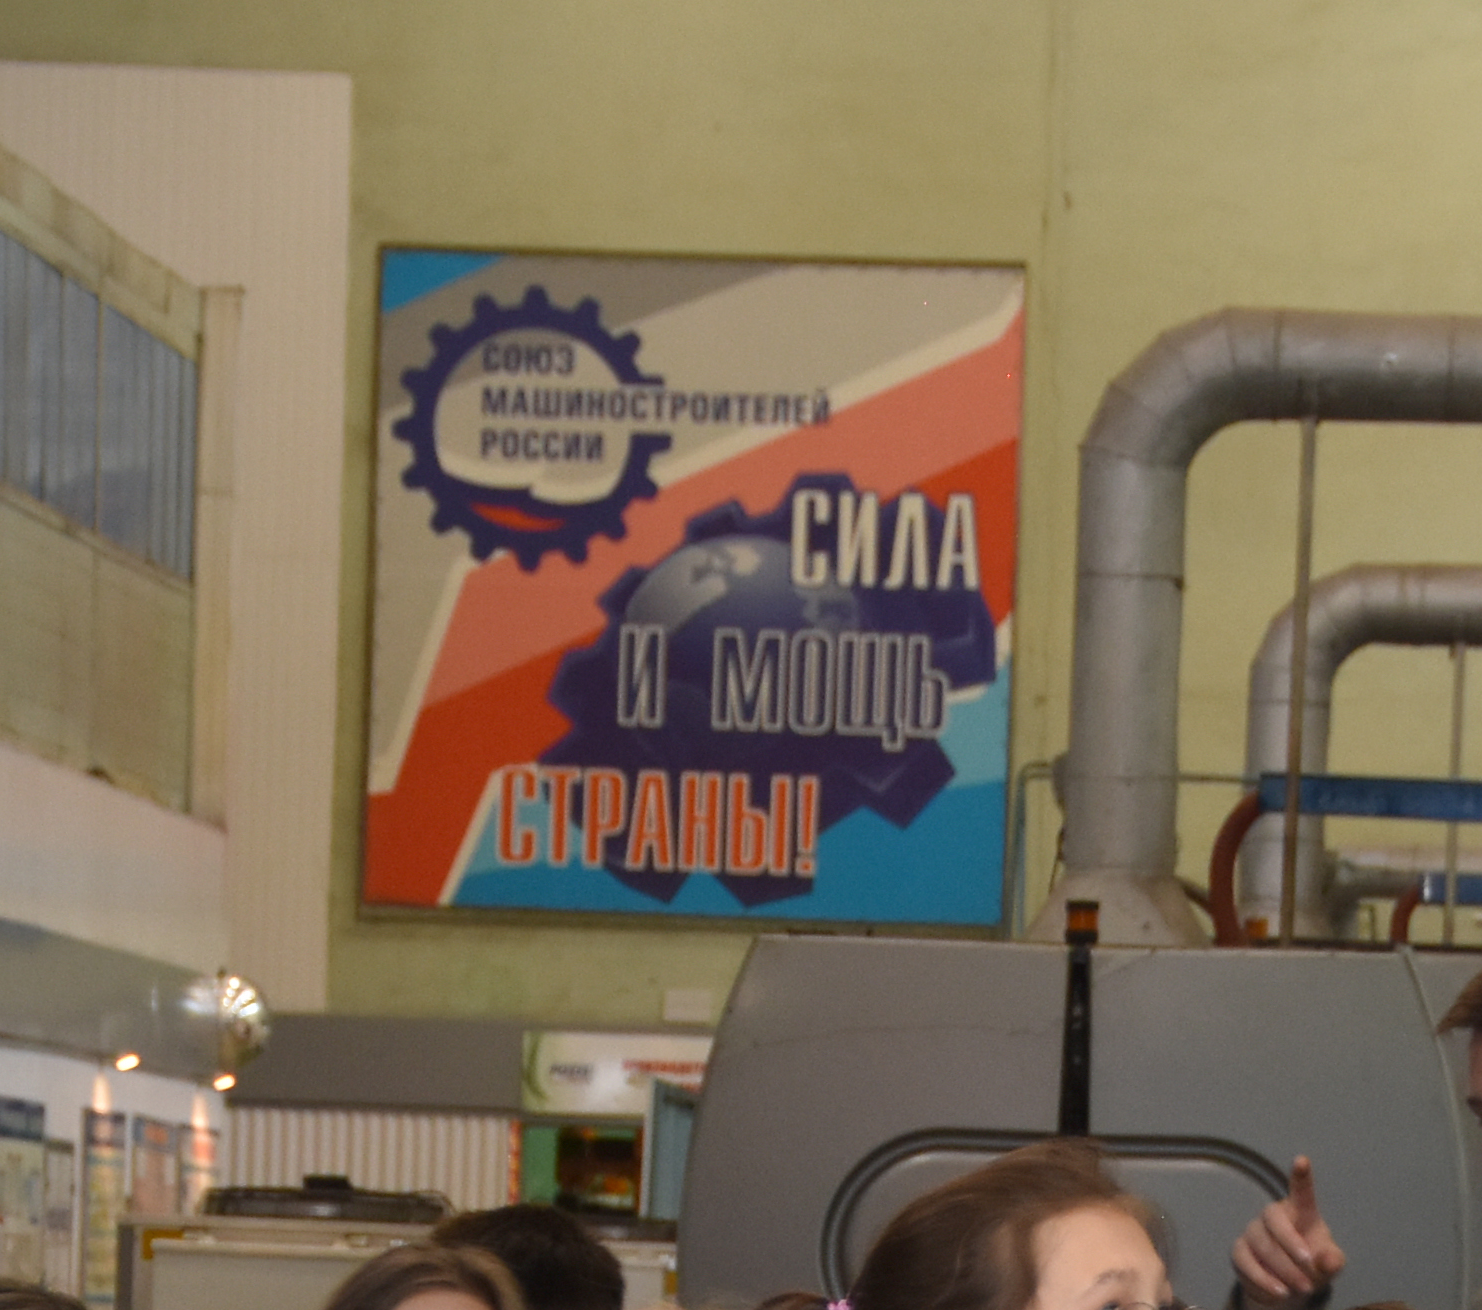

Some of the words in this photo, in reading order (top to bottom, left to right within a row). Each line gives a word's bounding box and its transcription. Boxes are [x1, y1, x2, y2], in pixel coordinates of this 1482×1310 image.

[481, 344, 575, 375] СОЮЗ
[480, 384, 831, 426] МАШИНОСТРОИТЕЛЕЙ
[480, 426, 604, 462] РОССИИ
[790, 488, 980, 592] СИЛА
[616, 623, 667, 728] И
[711, 627, 948, 752] МОЩЬ
[494, 764, 821, 878] СТРАНЫ!
